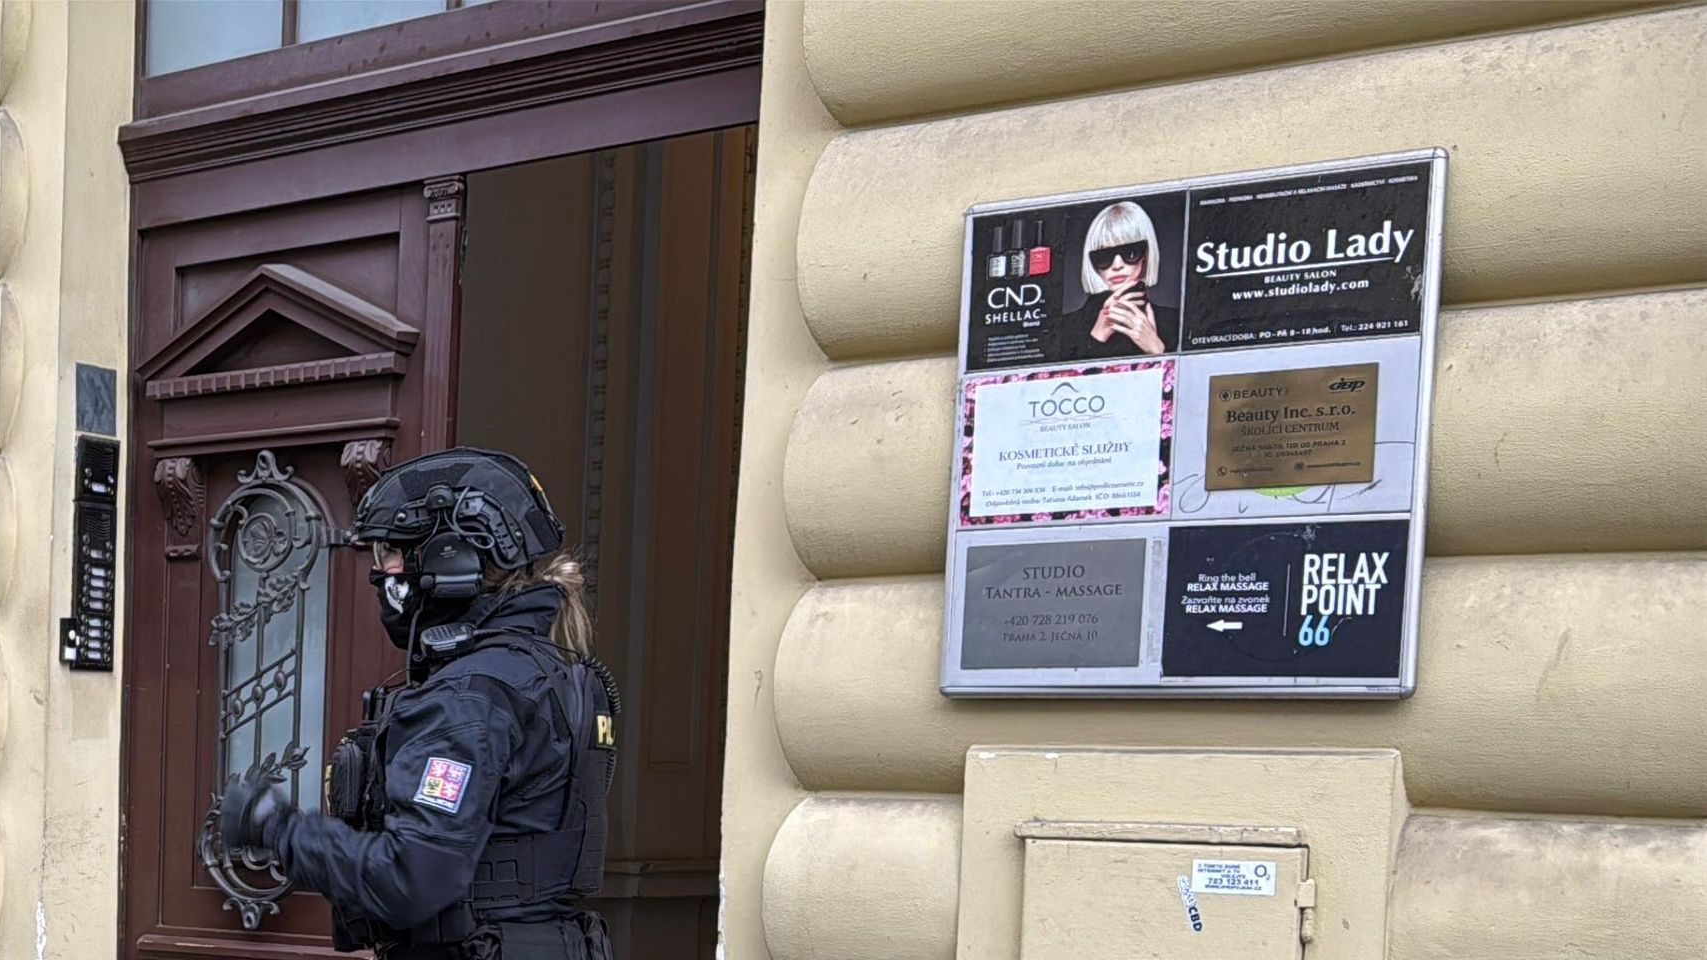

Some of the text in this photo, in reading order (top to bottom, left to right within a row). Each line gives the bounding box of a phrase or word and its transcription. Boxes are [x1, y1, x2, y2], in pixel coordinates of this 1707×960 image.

[1196, 220, 1415, 273] Studio Lady
[1264, 270, 1338, 284] BEAUTY SALON
[987, 284, 1042, 309] CND
[1232, 278, 1370, 300] www.studiolady.com
[985, 308, 1041, 325] SHELLAC
[1233, 387, 1282, 399] BEAUTY
[1028, 395, 1105, 417] TOCCO
[1226, 405, 1356, 424] Beauty Inc. s.r.o.
[1285, 422, 1340, 434] CENTRUM
[999, 441, 1132, 461] KOSMETICKÉ SLUŽBY
[1022, 565, 1085, 580] STUDIO
[1302, 552, 1390, 585] RELAX
[1198, 572, 1256, 583] Ring the bell
[985, 586, 1041, 600] TANTRA
[1055, 584, 1123, 598] MASSAGE
[1187, 582, 1269, 592] RELAX MASSAGE
[1224, 596, 1236, 604] na
[1237, 595, 1271, 604] zvonek
[1300, 583, 1381, 616] POINT
[1185, 603, 1268, 614] RELAX MASSAGE
[1032, 615, 1051, 626] 728
[1056, 614, 1075, 625] 219
[1078, 613, 1098, 624] 076
[1002, 632, 1036, 642] PRAHA
[1299, 615, 1330, 646] 66
[1188, 906, 1202, 932] CBD
